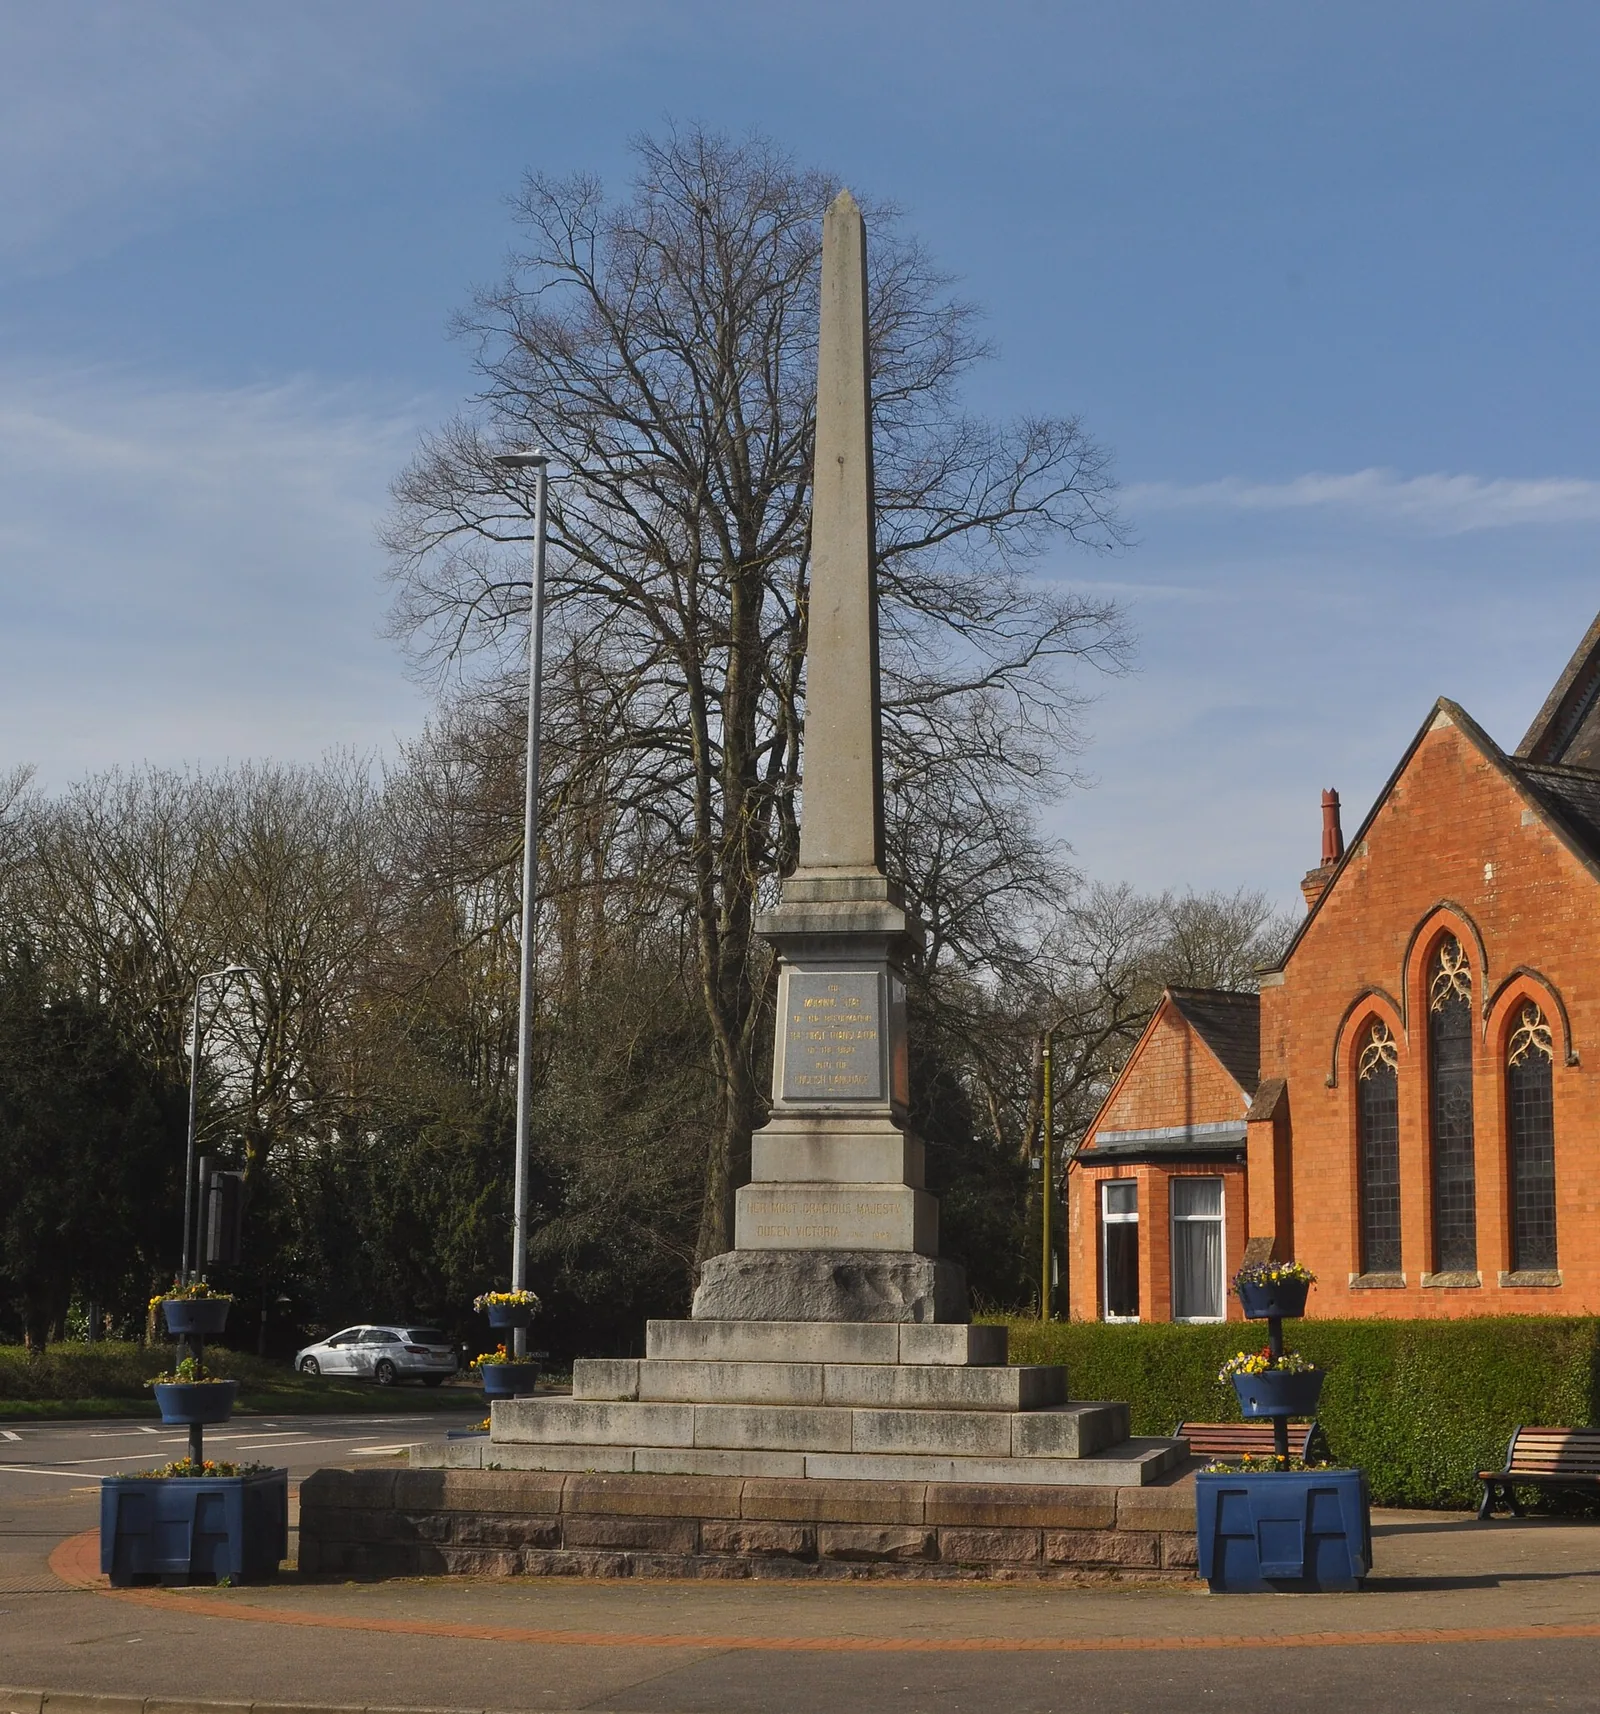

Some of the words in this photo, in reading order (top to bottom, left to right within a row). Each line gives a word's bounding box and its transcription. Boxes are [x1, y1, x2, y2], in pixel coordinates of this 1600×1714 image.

[771, 1203, 797, 1214] MOST
[802, 1203, 851, 1214] GRACIOUS
[856, 1203, 901, 1215] MAJESTY
[757, 1225, 790, 1237] QUEEN
[796, 1225, 841, 1237] VICTORIA
